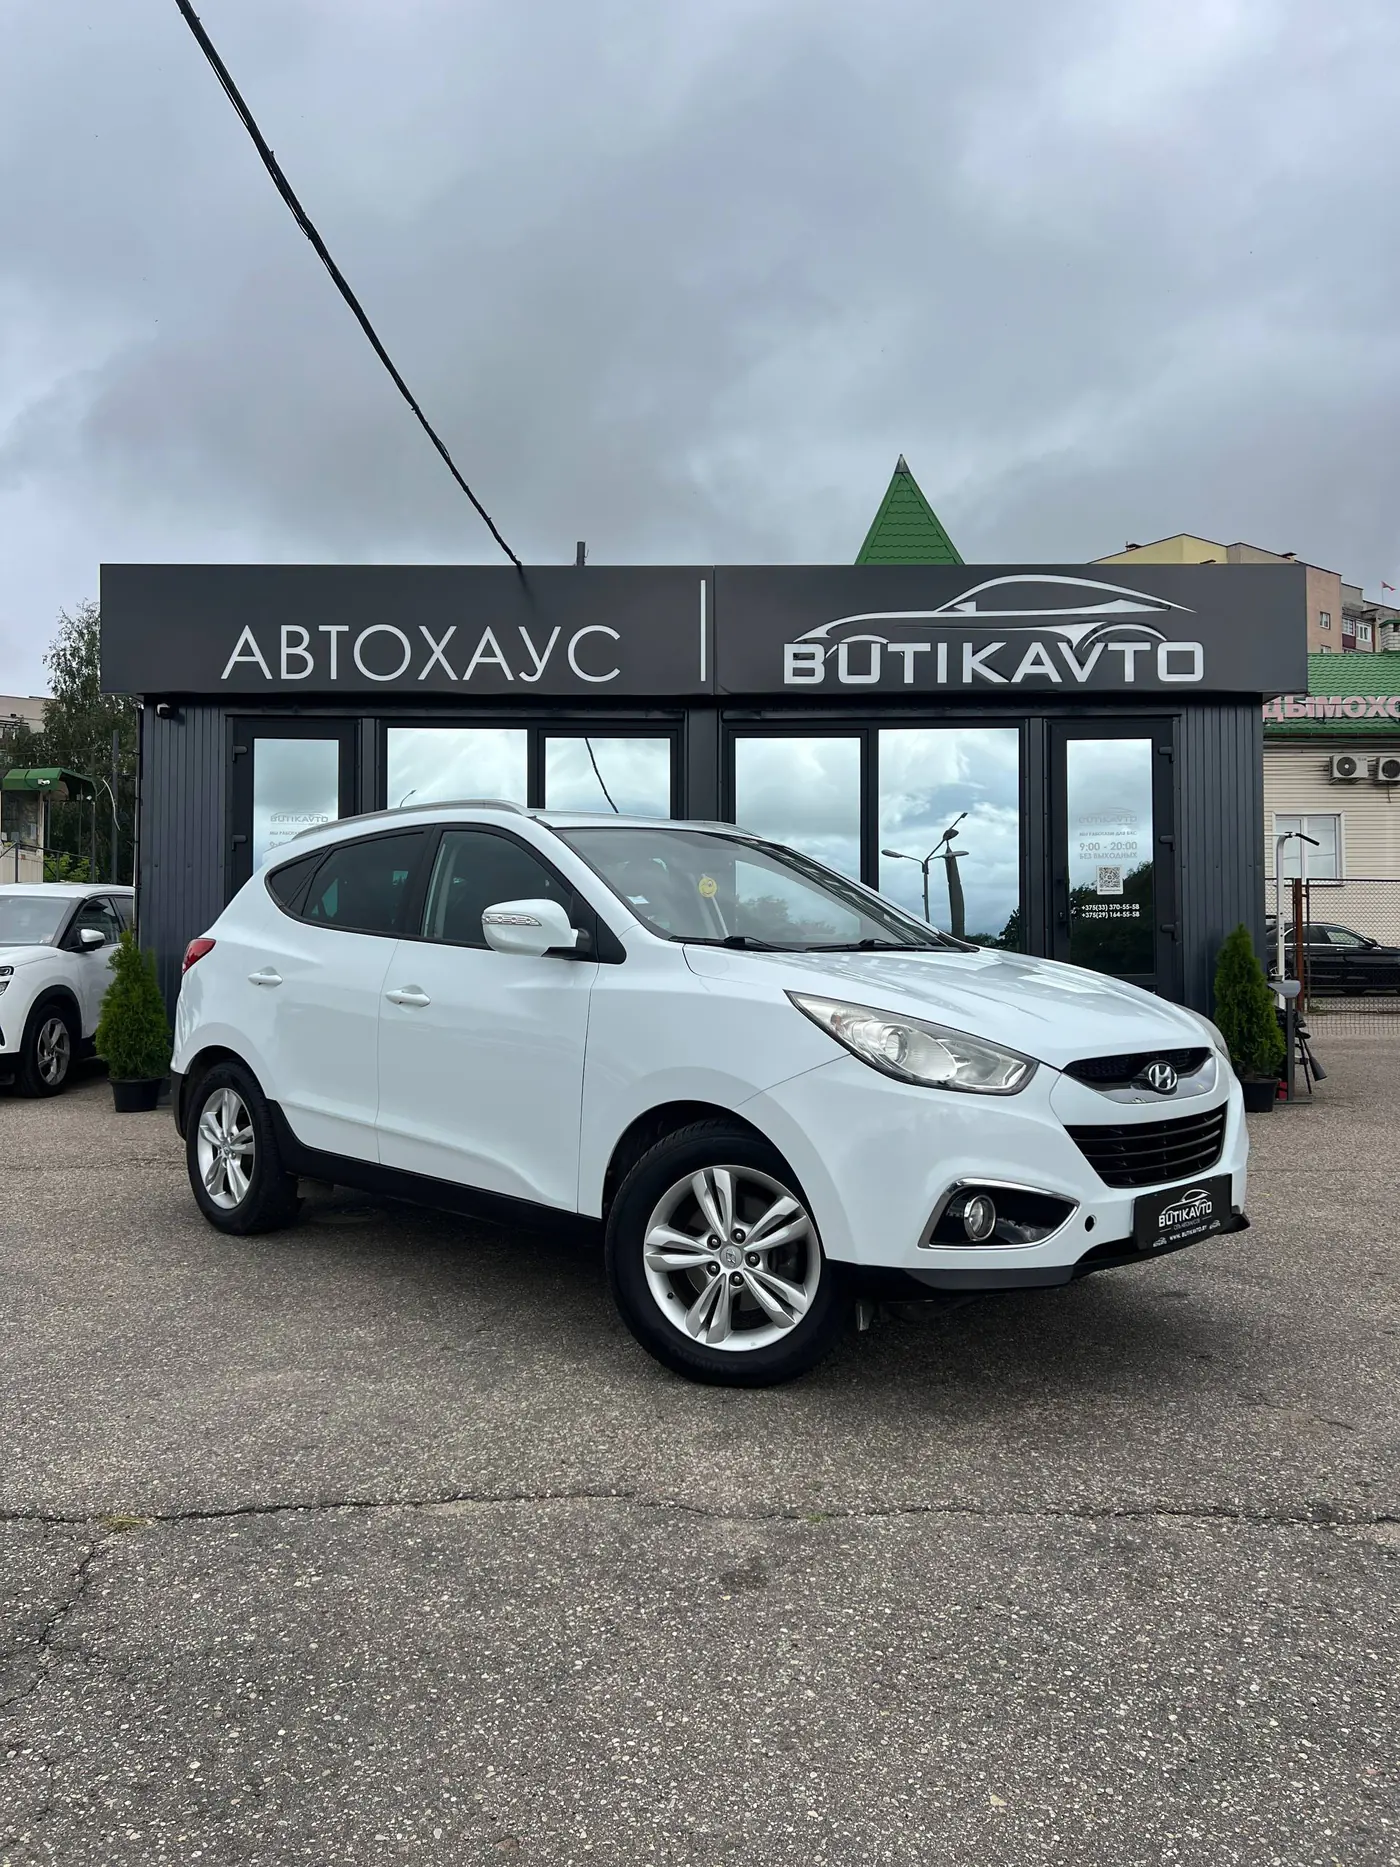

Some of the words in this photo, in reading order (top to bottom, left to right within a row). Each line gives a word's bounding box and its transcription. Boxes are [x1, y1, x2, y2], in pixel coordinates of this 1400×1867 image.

[220, 624, 621, 683] АВТОХАУС
[783, 641, 1204, 685] BUTIKAVTO
[1080, 842, 1100, 851] 9:00
[1110, 841, 1138, 851] 20:00
[1081, 911, 1109, 919] +375(29)
[1158, 1201, 1212, 1227] BUTIKAVTO
